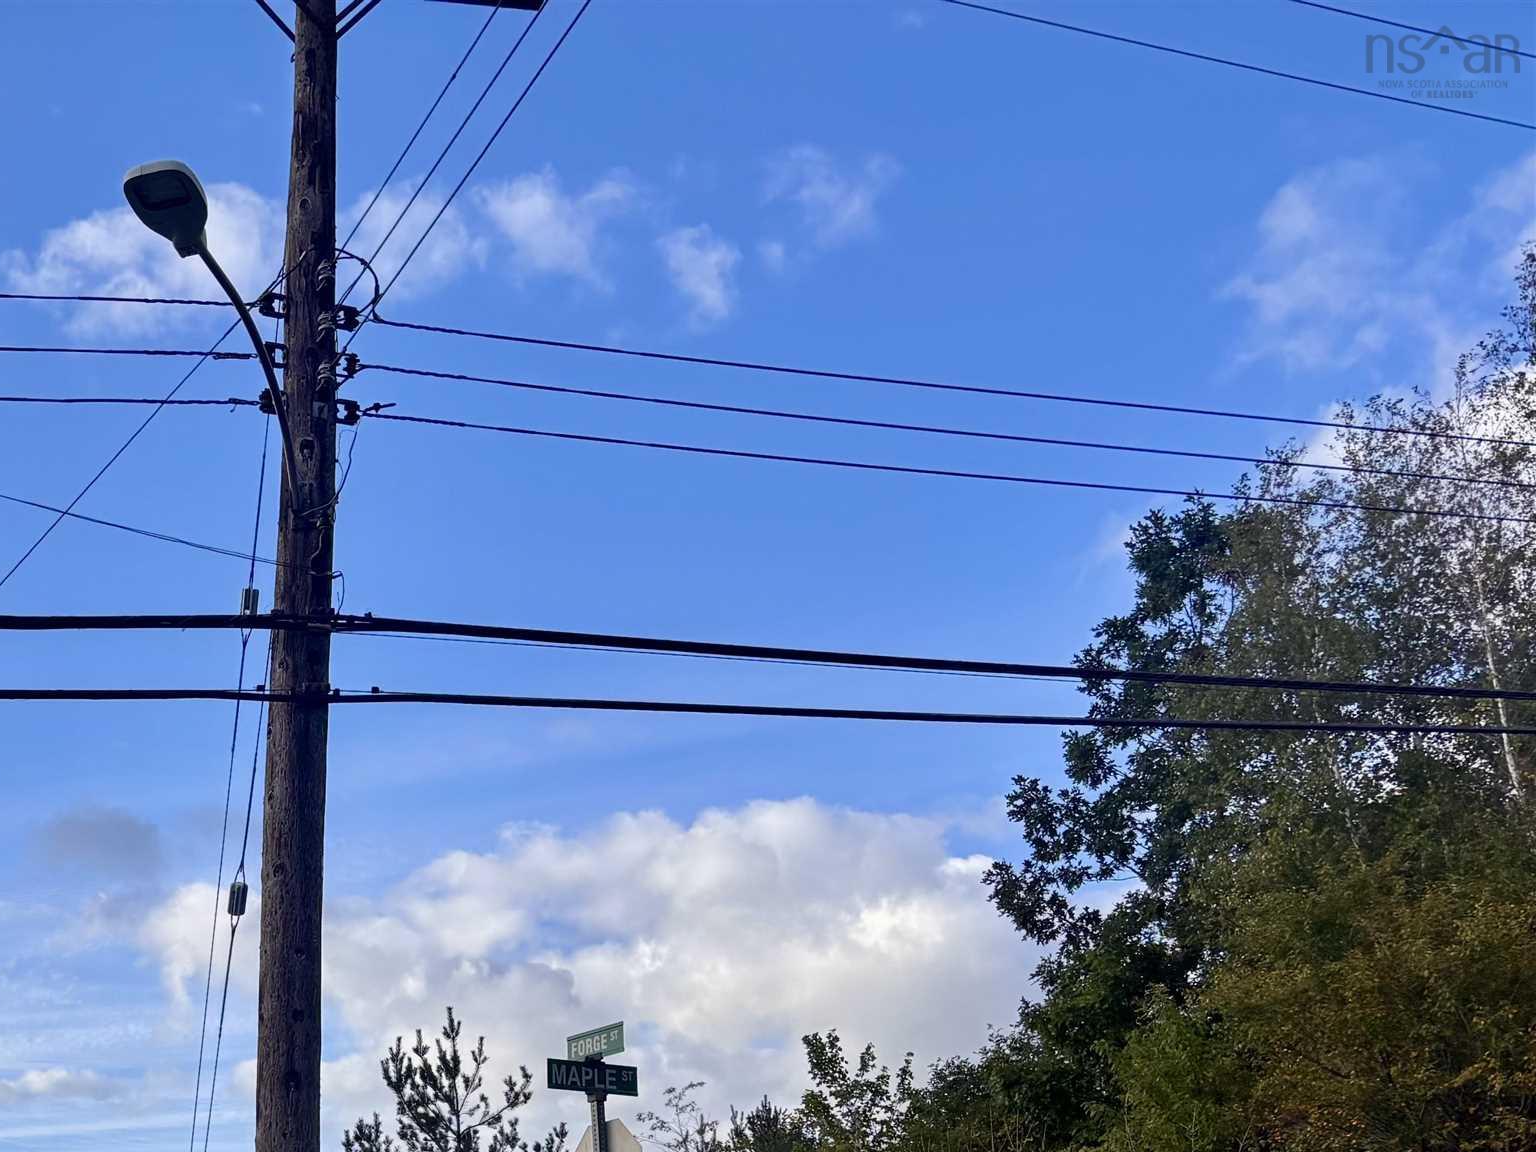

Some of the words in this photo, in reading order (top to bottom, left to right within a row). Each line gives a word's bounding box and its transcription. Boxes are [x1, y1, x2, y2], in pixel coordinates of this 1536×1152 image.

[571, 1034, 607, 1058] FORGE
[610, 1030, 618, 1041] ST
[552, 1064, 617, 1089] MAPLE
[622, 1070, 633, 1081] ST
